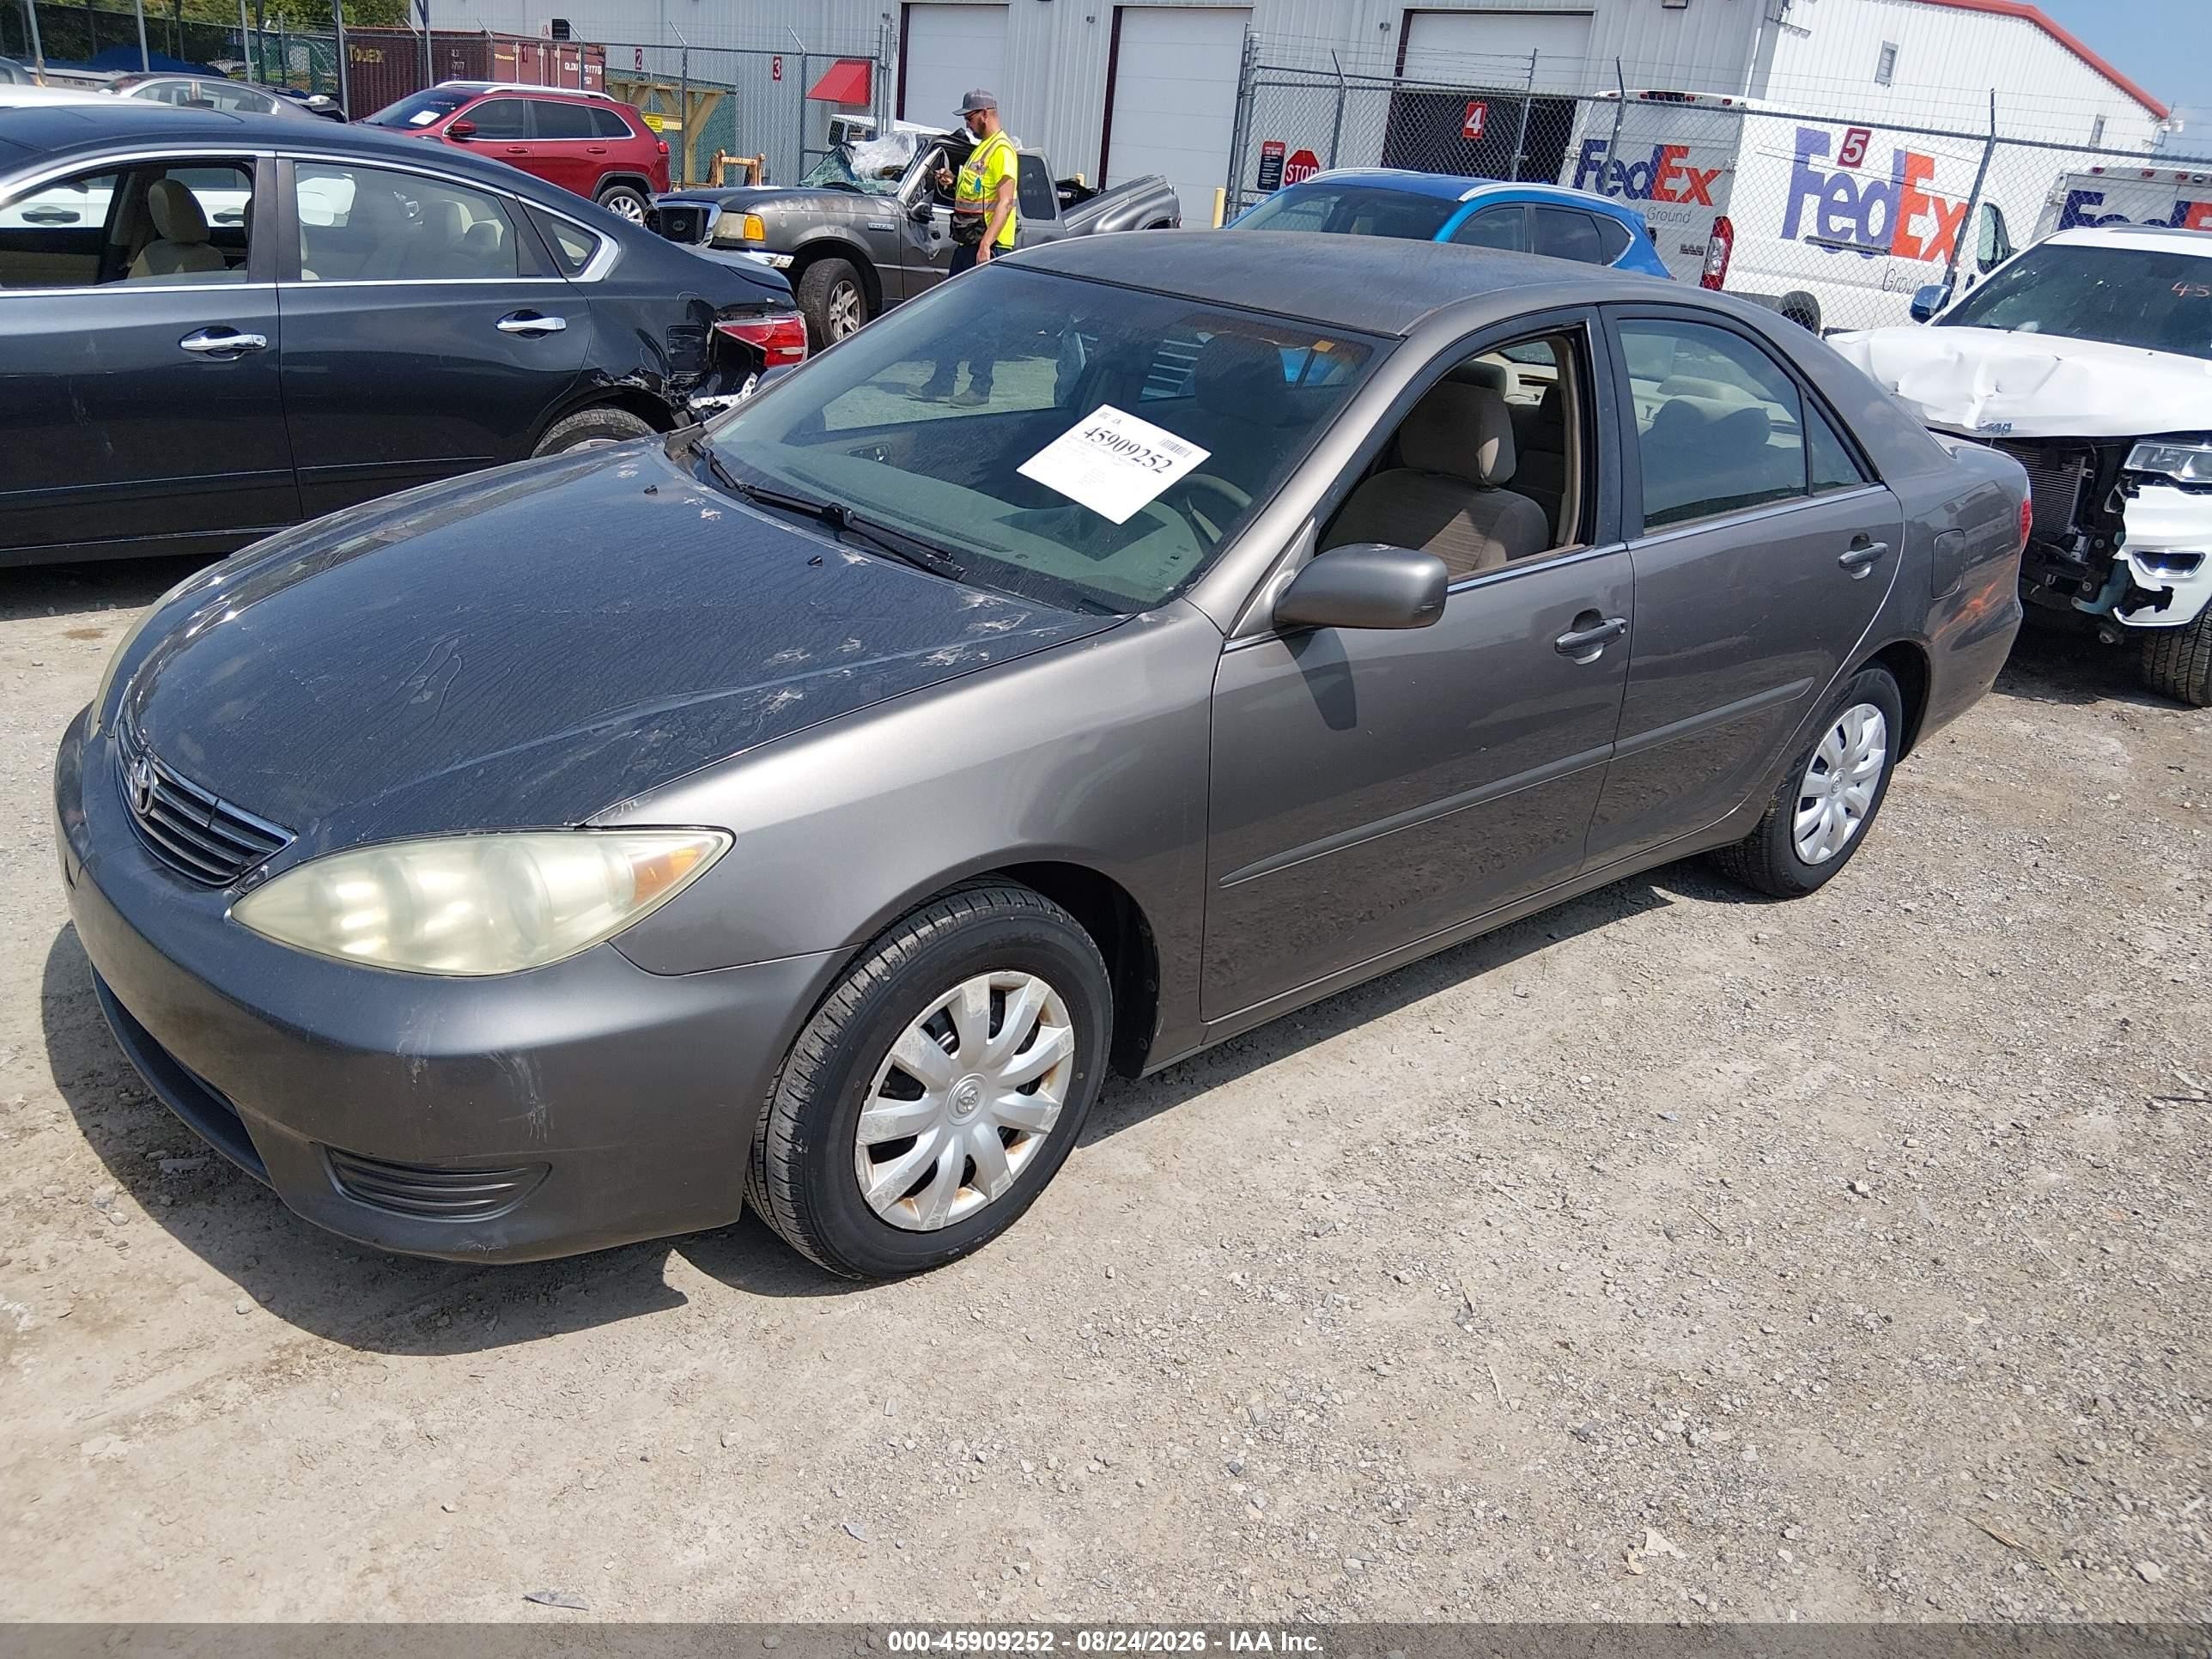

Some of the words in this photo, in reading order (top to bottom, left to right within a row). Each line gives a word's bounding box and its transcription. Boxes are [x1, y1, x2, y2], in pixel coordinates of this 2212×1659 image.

[635, 51, 642, 68] 2
[774, 59, 781, 78] 3
[1466, 107, 1483, 134] 4
[1842, 134, 1867, 162] 5
[1286, 164, 1318, 182] STOP
[1572, 139, 1722, 206] FedEx
[1781, 127, 1969, 269] FedEx
[1647, 208, 1691, 223] Ground
[1882, 269, 1923, 295] Grou
[1084, 427, 1173, 473] 45909252
